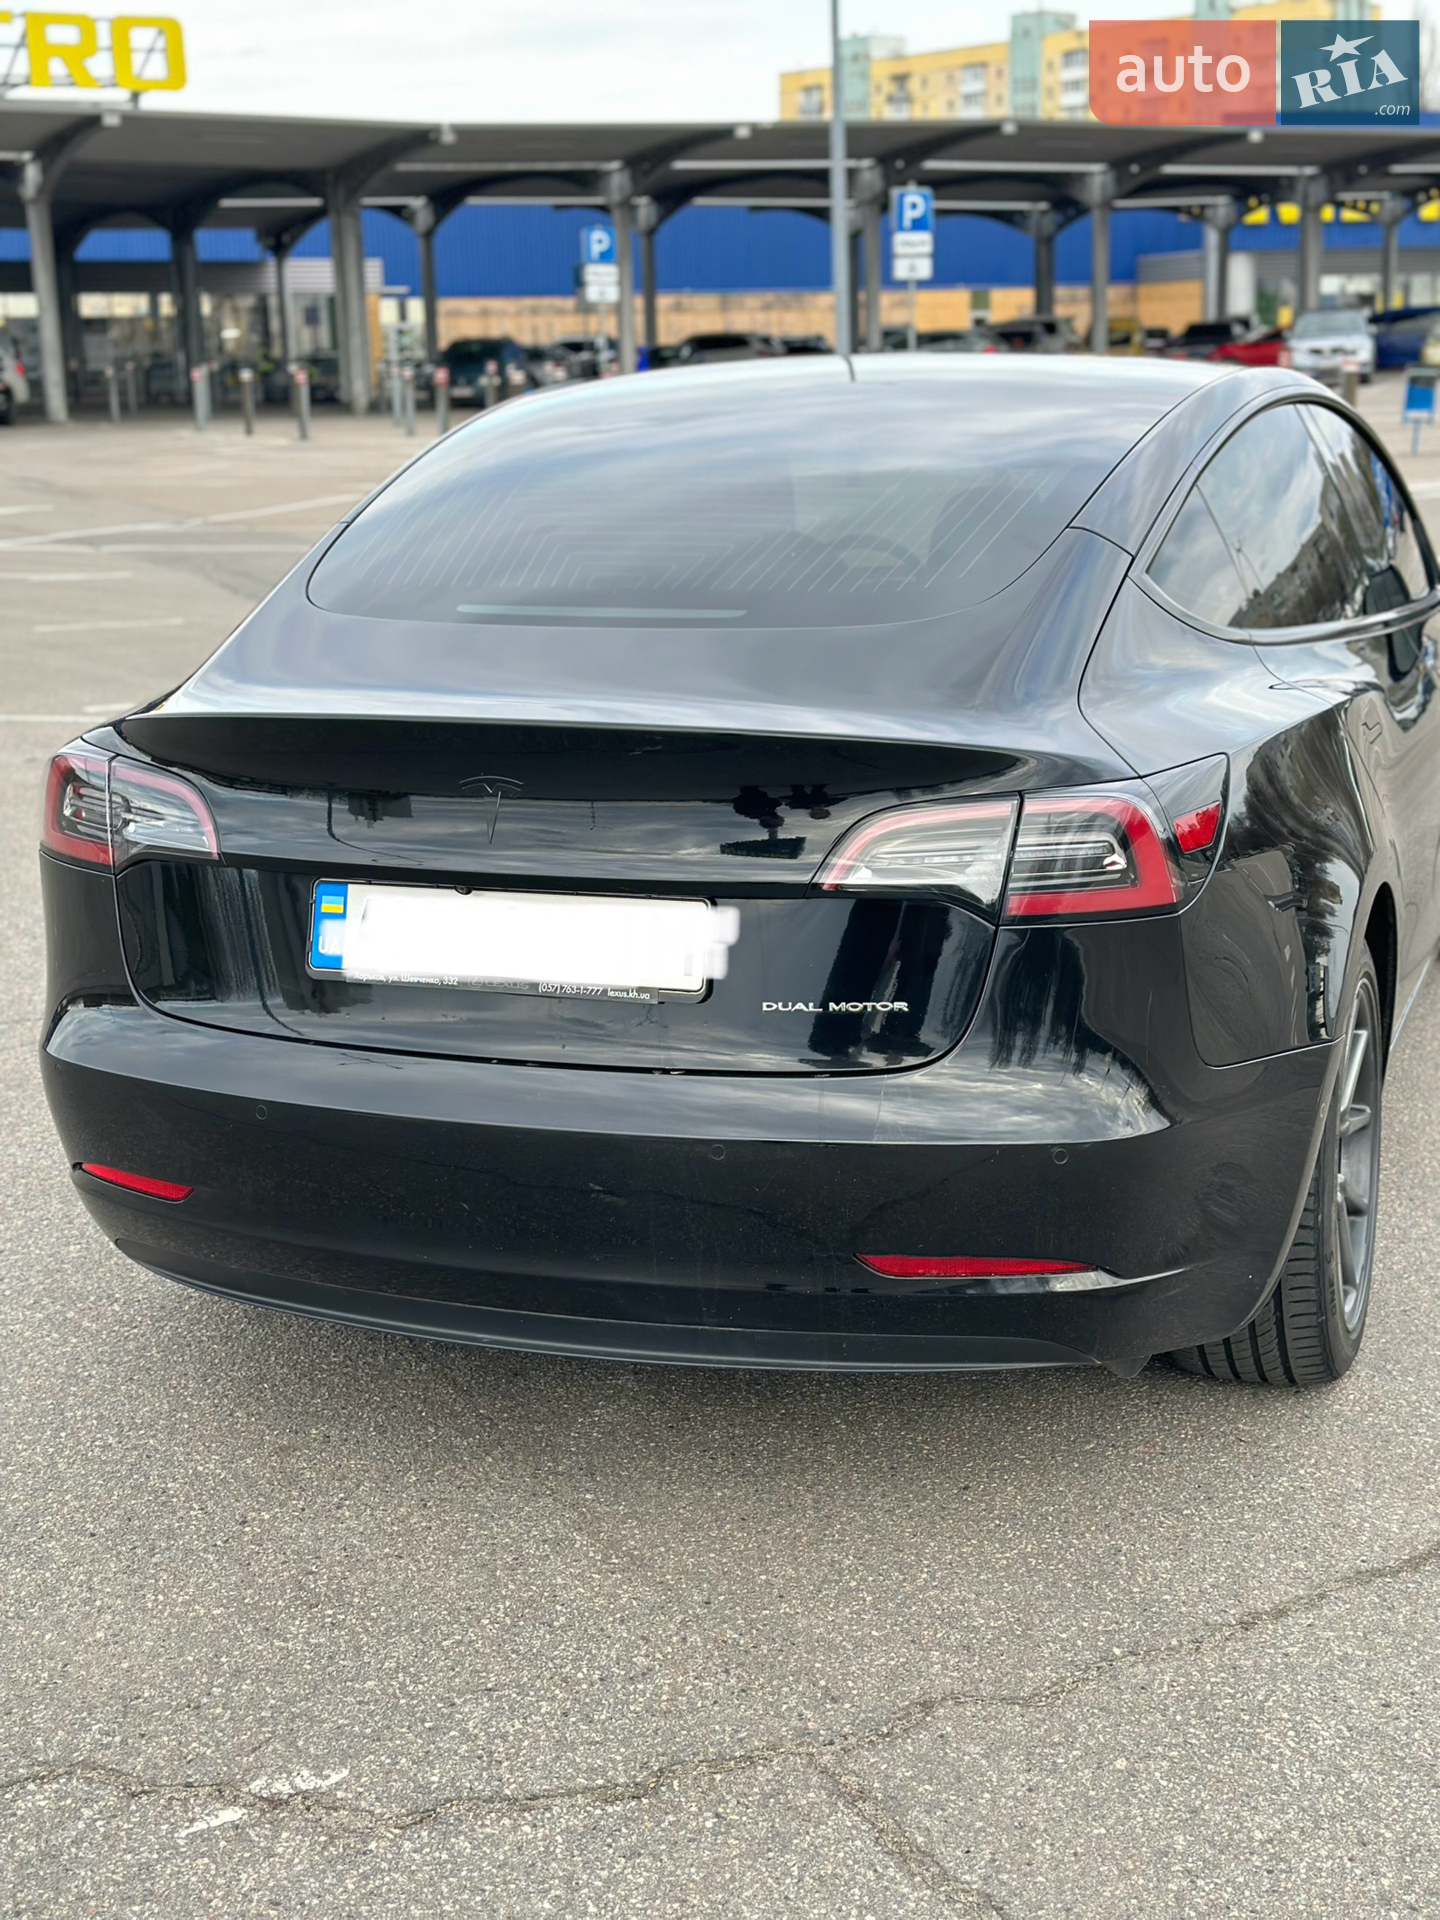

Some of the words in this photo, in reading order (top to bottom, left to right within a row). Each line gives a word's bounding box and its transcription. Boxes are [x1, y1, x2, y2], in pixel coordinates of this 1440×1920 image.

[0, 11, 187, 92] RO
[902, 194, 926, 230] P
[589, 229, 611, 261] P
[442, 976, 459, 986] 332
[538, 982, 560, 994] (057)
[561, 984, 603, 996] 763-1-777
[607, 988, 650, 1000] lexus.kh.ua
[762, 1001, 823, 1012] DUAL
[828, 1001, 909, 1012] MOTOR
